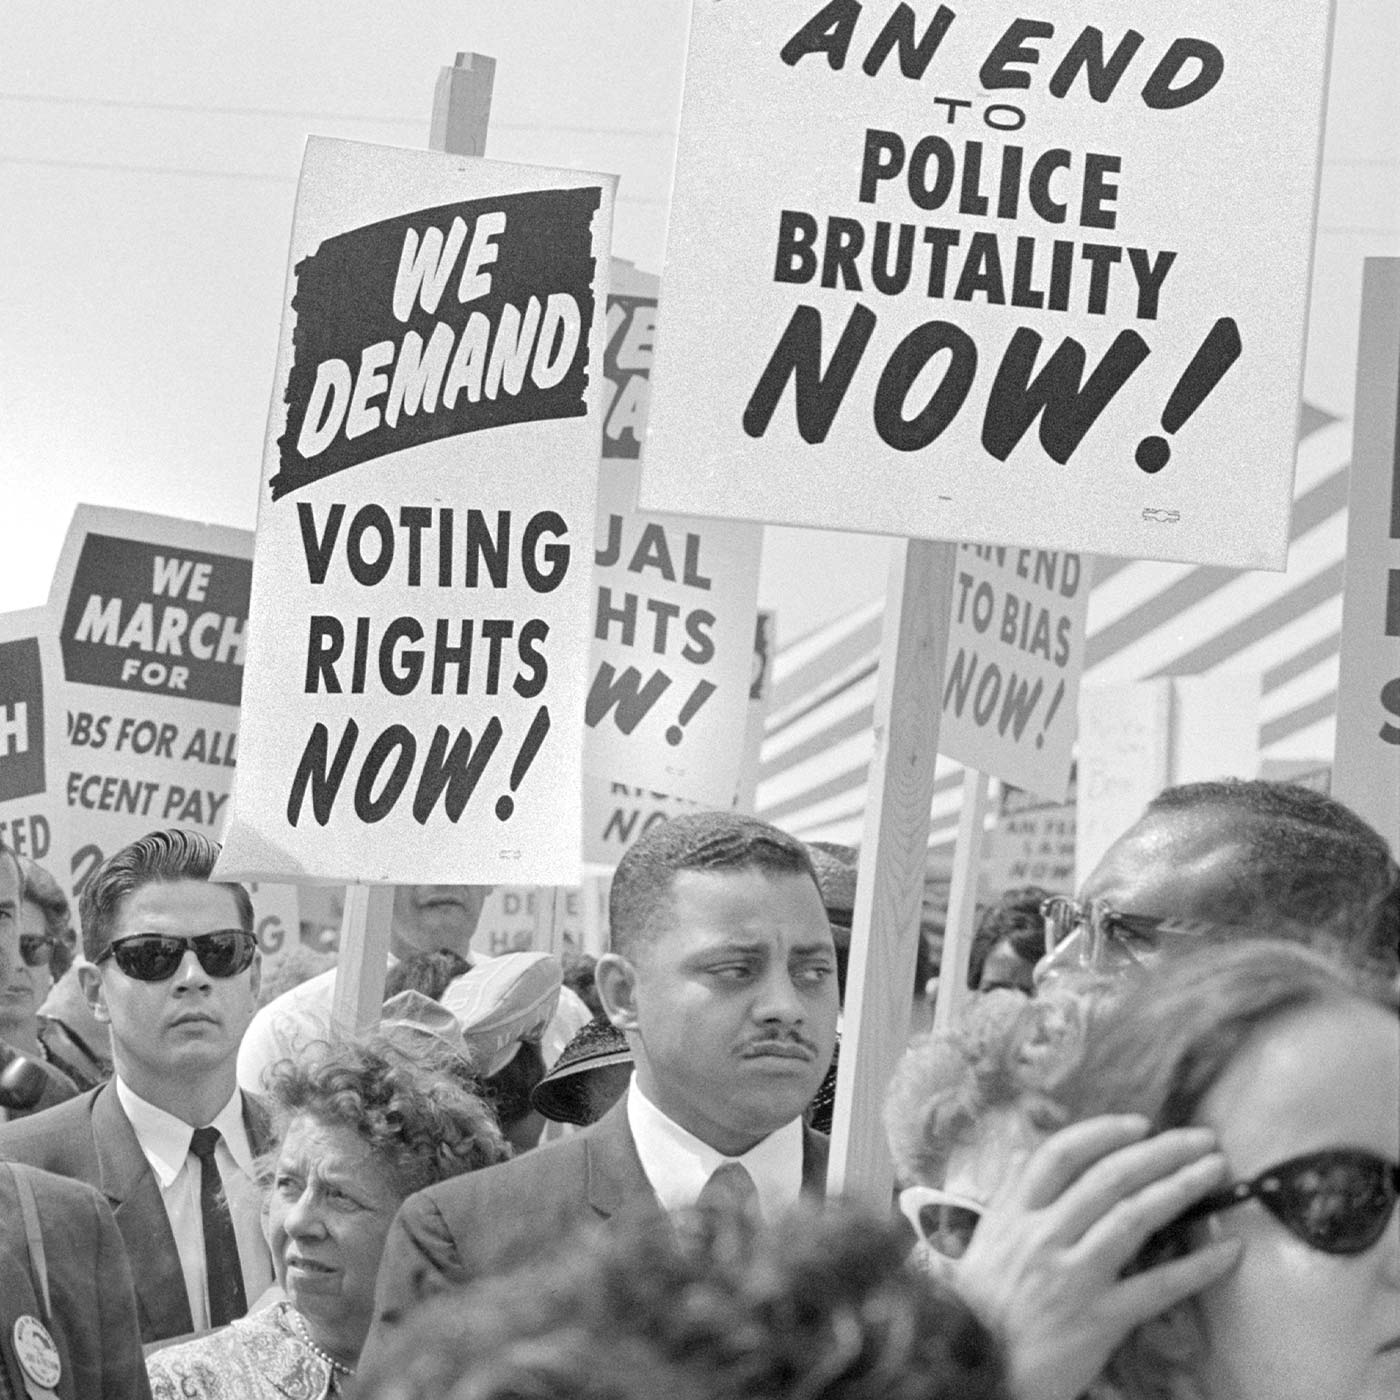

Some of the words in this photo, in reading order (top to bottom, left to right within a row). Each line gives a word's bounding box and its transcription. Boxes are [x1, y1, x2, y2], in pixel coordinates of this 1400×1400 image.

[780, 0, 956, 79] AN
[979, 17, 1225, 110] END
[934, 97, 1025, 131] TO
[859, 128, 1122, 229] POLICE
[394, 212, 506, 322] WE
[773, 209, 1177, 320] BRUTALITY
[297, 293, 581, 458] DEMAND
[743, 303, 1242, 474] NOW!
[153, 556, 212, 602] WE
[297, 502, 570, 593] VOTING
[1016, 549, 1080, 598] END
[74, 594, 249, 665] MARCH
[304, 615, 550, 698] RIGHTS
[959, 571, 994, 634] TO
[1000, 592, 1071, 668] BIAS
[121, 659, 189, 690] FOR
[943, 647, 1065, 750] NOW!
[115, 717, 178, 758] FOR
[182, 728, 236, 767] ALL
[288, 705, 550, 827] NOW!
[162, 785, 229, 825] PAY
